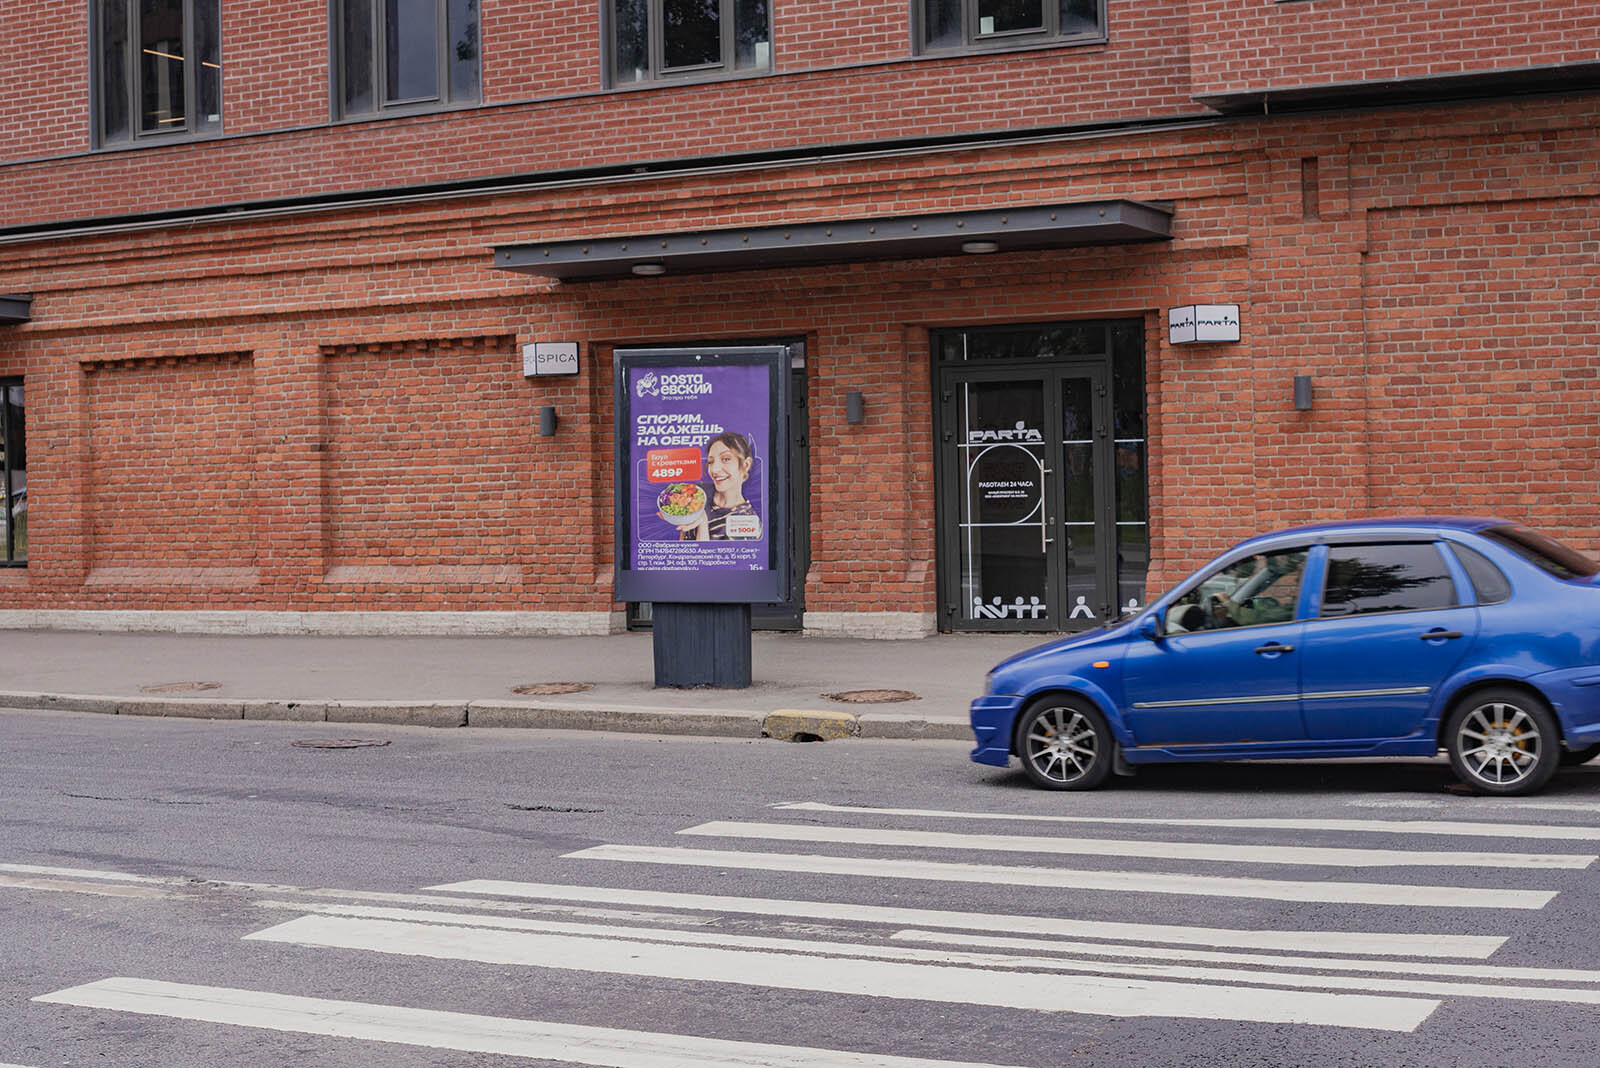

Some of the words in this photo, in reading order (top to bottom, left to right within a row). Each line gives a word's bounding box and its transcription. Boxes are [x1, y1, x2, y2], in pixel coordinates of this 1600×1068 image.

[1198, 316, 1238, 326] PARTA
[538, 353, 576, 363] SPICA
[637, 414, 704, 425] СПОРИМ,
[637, 424, 724, 436] ЗАКАЖЕШЬ
[969, 421, 1042, 441] PARTA
[637, 437, 658, 446] НА
[660, 436, 710, 447] ОБЕД?
